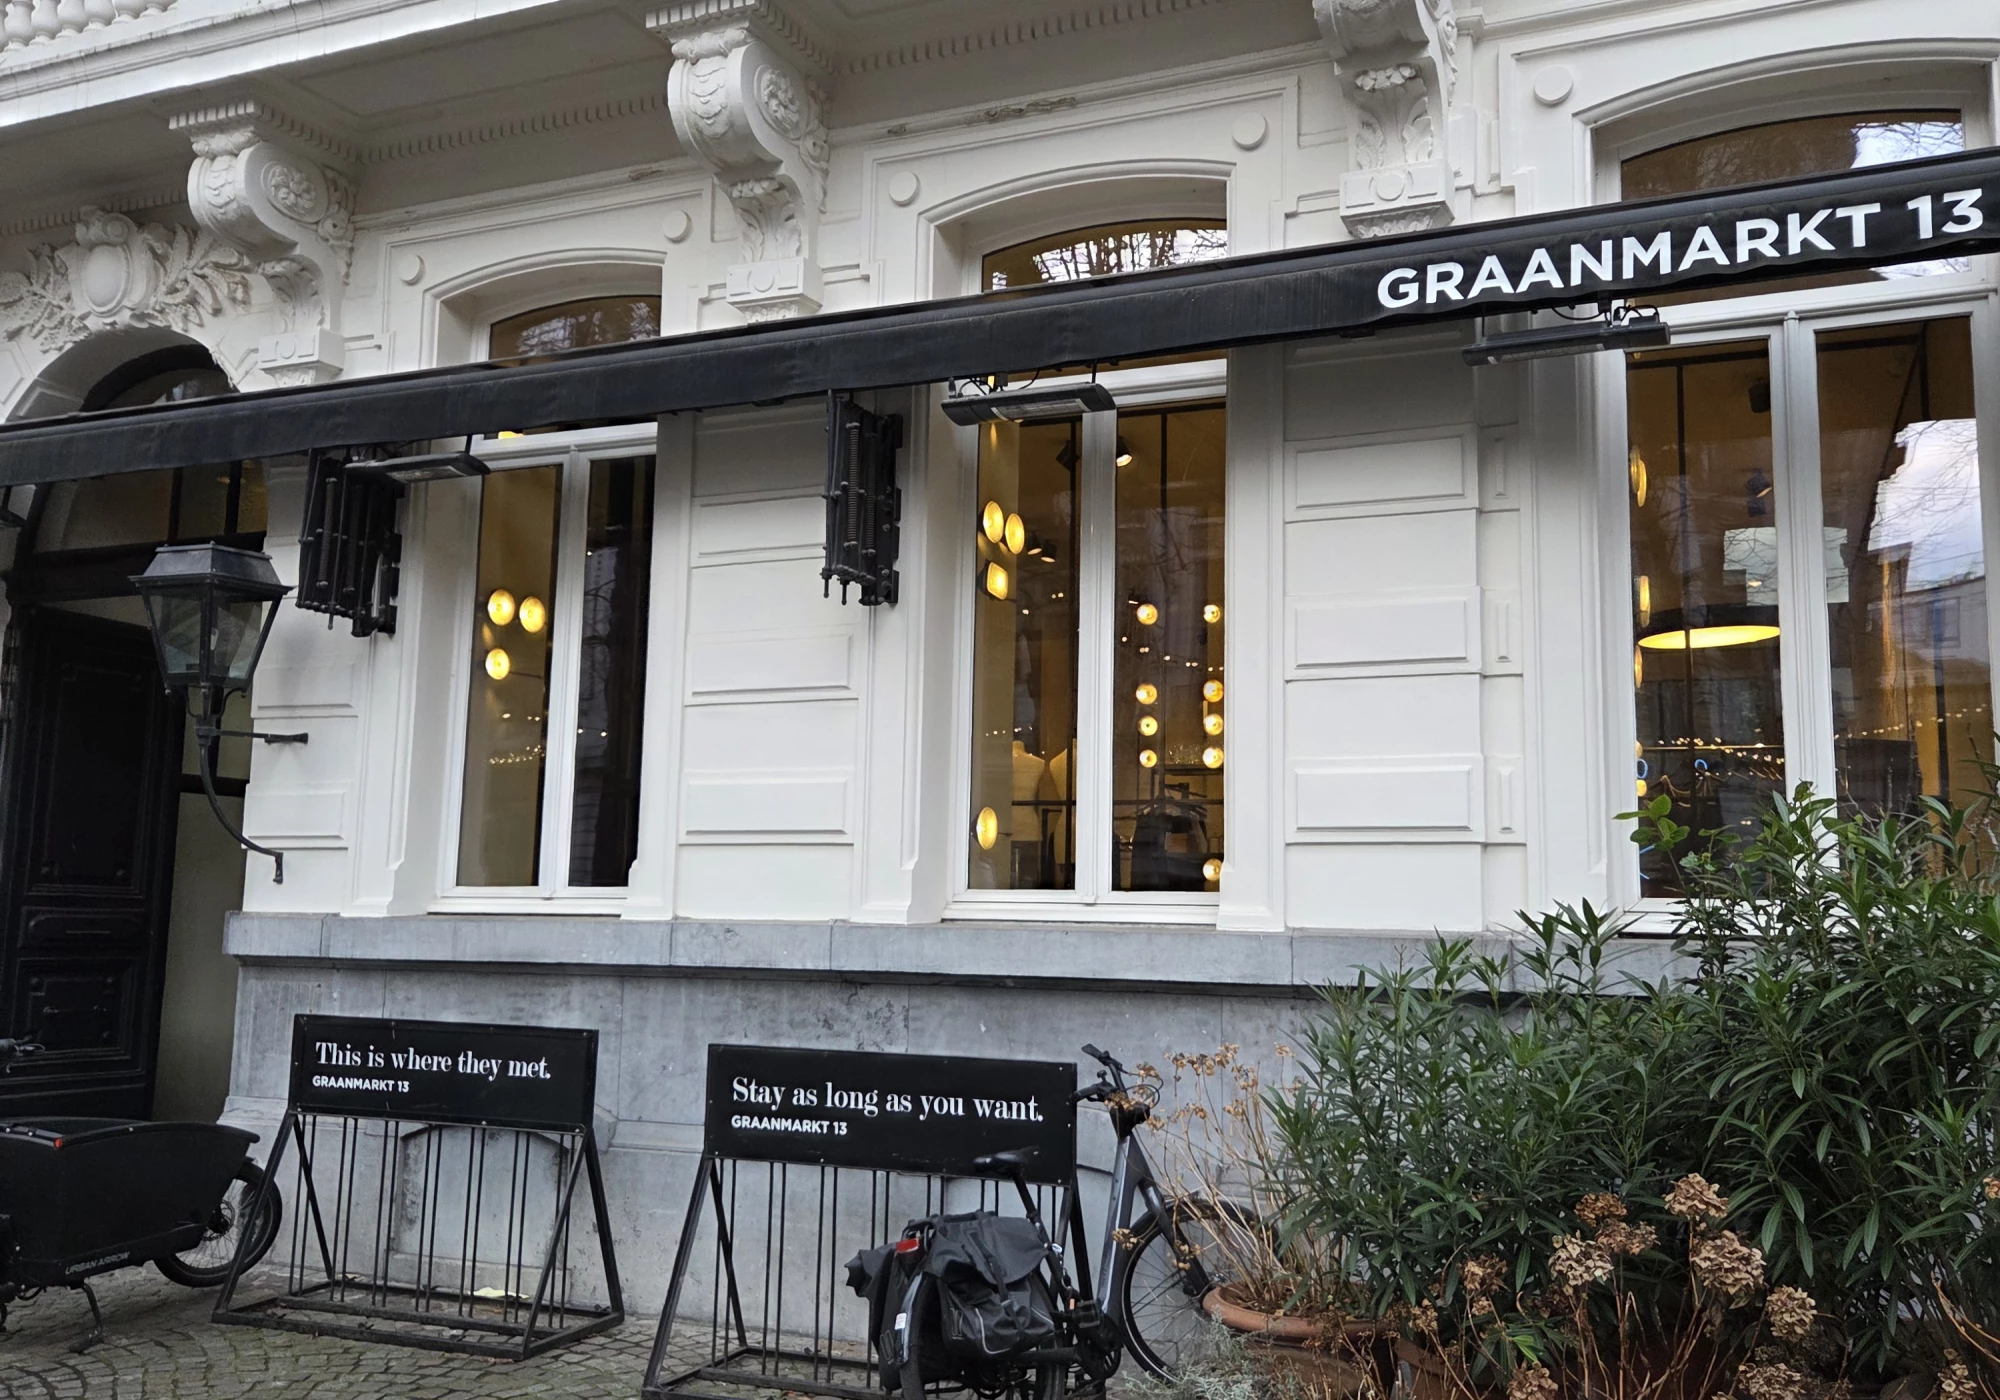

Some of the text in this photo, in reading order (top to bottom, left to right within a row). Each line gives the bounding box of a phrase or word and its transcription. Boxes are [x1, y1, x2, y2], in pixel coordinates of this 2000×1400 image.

[1377, 189, 1984, 309] GRAANMARKT 13
[315, 1041, 552, 1082] This is where they met.
[311, 1075, 410, 1093] GRAANMARKT 13
[731, 1076, 1044, 1123] Stay as long as you want.
[731, 1114, 848, 1136] GRAANMARKT 13
[65, 1251, 130, 1275] URBAN ARROW
